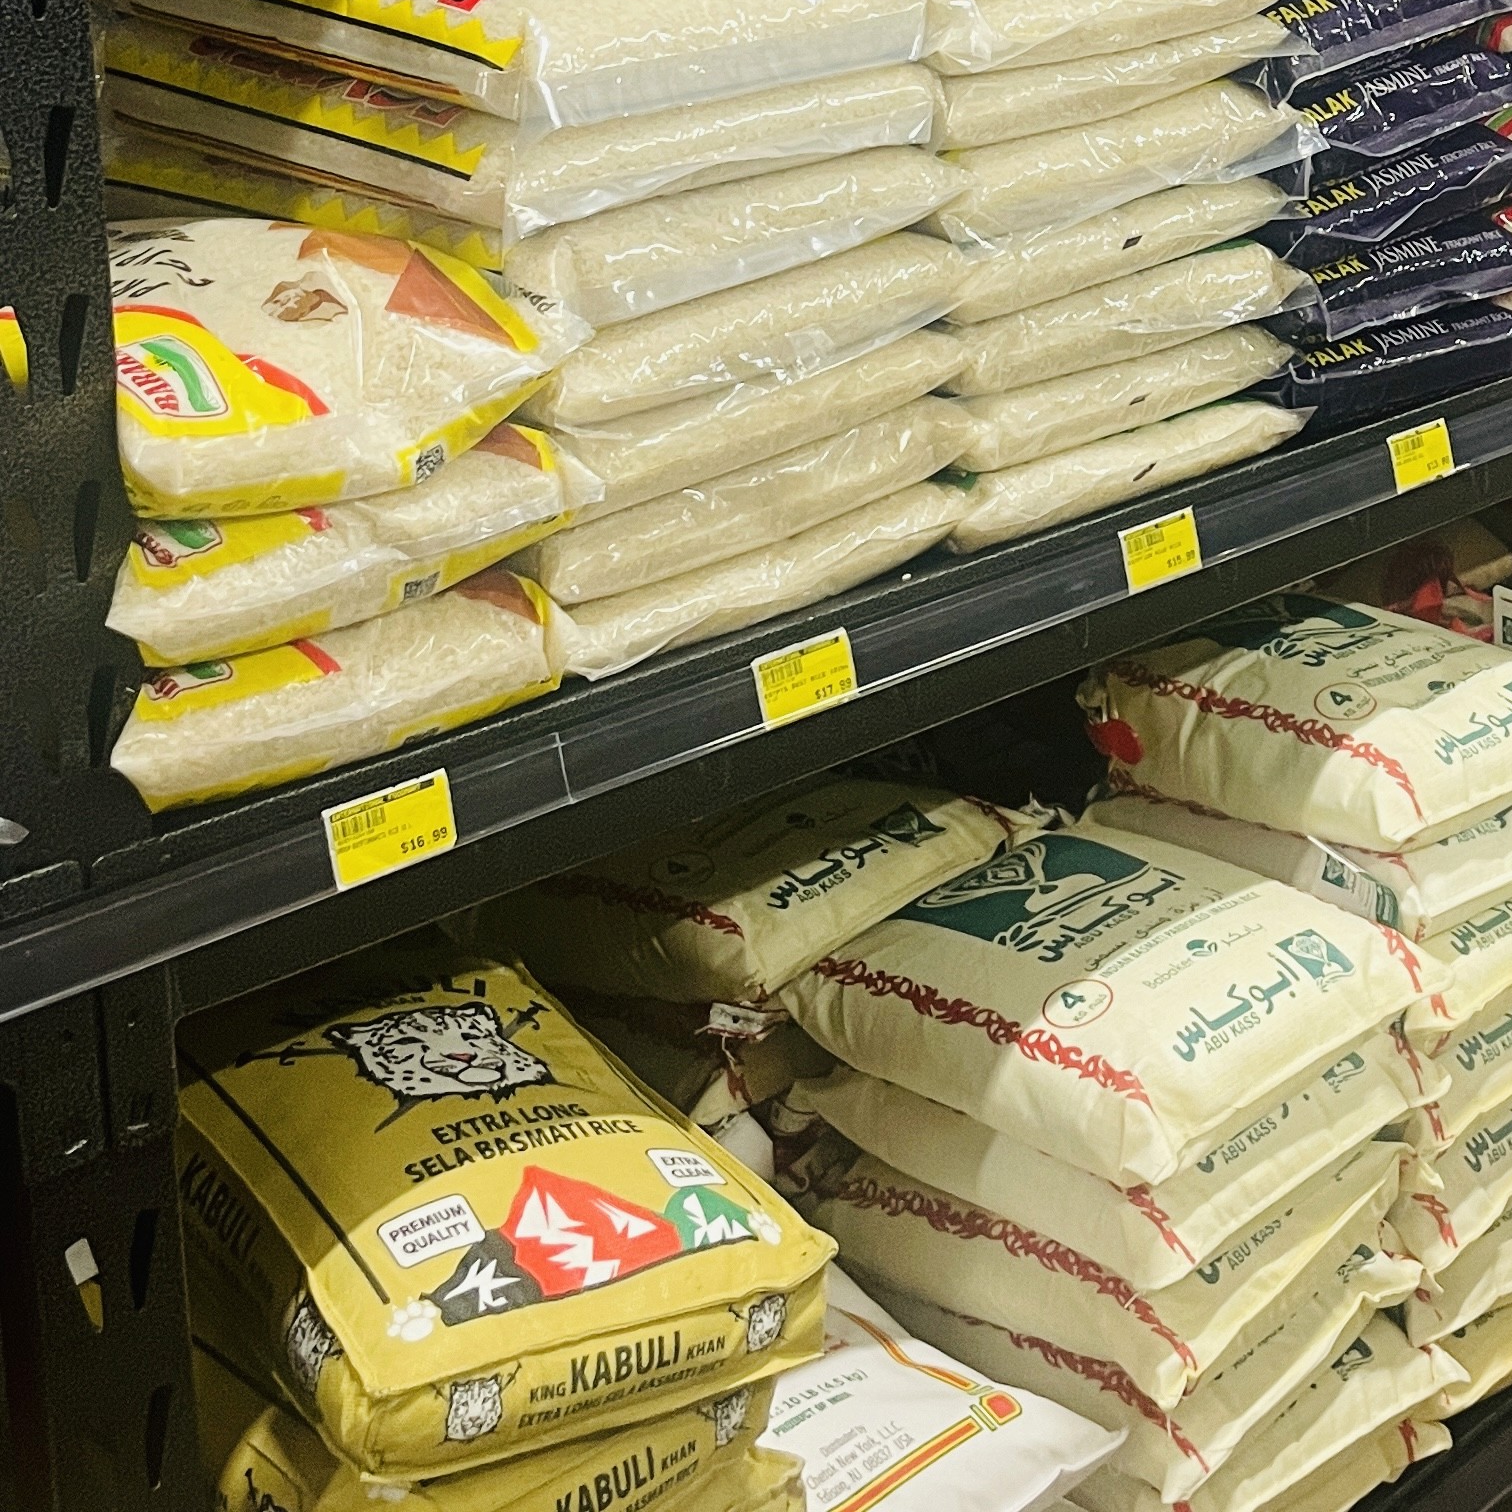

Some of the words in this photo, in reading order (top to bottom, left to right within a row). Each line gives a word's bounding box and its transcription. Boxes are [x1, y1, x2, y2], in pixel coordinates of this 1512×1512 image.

[1356, 63, 1433, 101] JASMINE
[1362, 152, 1440, 197] JASMINE
[1368, 235, 1444, 273] JASMINE
[1371, 318, 1450, 356] JASMINE
[1329, 690, 1354, 707] 4
[1459, 743, 1480, 761] ABU
[1480, 733, 1503, 752] KASS
[1099, 958, 1130, 980] INDIAN
[1129, 937, 1167, 962] BASMATI
[1165, 911, 1211, 941] PARBOILED
[1142, 956, 1195, 990] Babaker
[1060, 990, 1086, 1010] 4
[1204, 1028, 1230, 1055] ABU
[1230, 1011, 1262, 1039] KASS
[1481, 1042, 1501, 1065] ABU
[432, 1109, 518, 1146] EXTRA
[518, 1102, 591, 1126] LONG
[1221, 1136, 1249, 1165] ABU
[1247, 1115, 1278, 1146] KASS
[404, 1146, 476, 1184] SELA
[476, 1124, 590, 1161] BASMATI
[593, 1117, 645, 1136] RICE
[661, 1155, 703, 1168] EXTRA
[1487, 1141, 1508, 1165] ABU
[671, 1166, 714, 1179] CLEAN
[388, 1203, 468, 1243] PREMIUM
[402, 1219, 471, 1255] QUALITY
[530, 1380, 567, 1404] KING
[570, 1330, 682, 1394] KABULI
[686, 1335, 727, 1359] KHAN
[784, 1393, 802, 1413] 10
[803, 1385, 819, 1404] LB
[845, 1367, 869, 1385] kg)
[517, 1406, 563, 1430] EXTRA
[772, 1408, 814, 1439] PRODUCT
[827, 1391, 854, 1408] INDIA
[837, 1447, 857, 1468] New
[863, 1447, 894, 1475] 08837
[895, 1432, 916, 1455] USA
[556, 1446, 656, 1512] KABULI
[660, 1440, 698, 1472] KHAN
